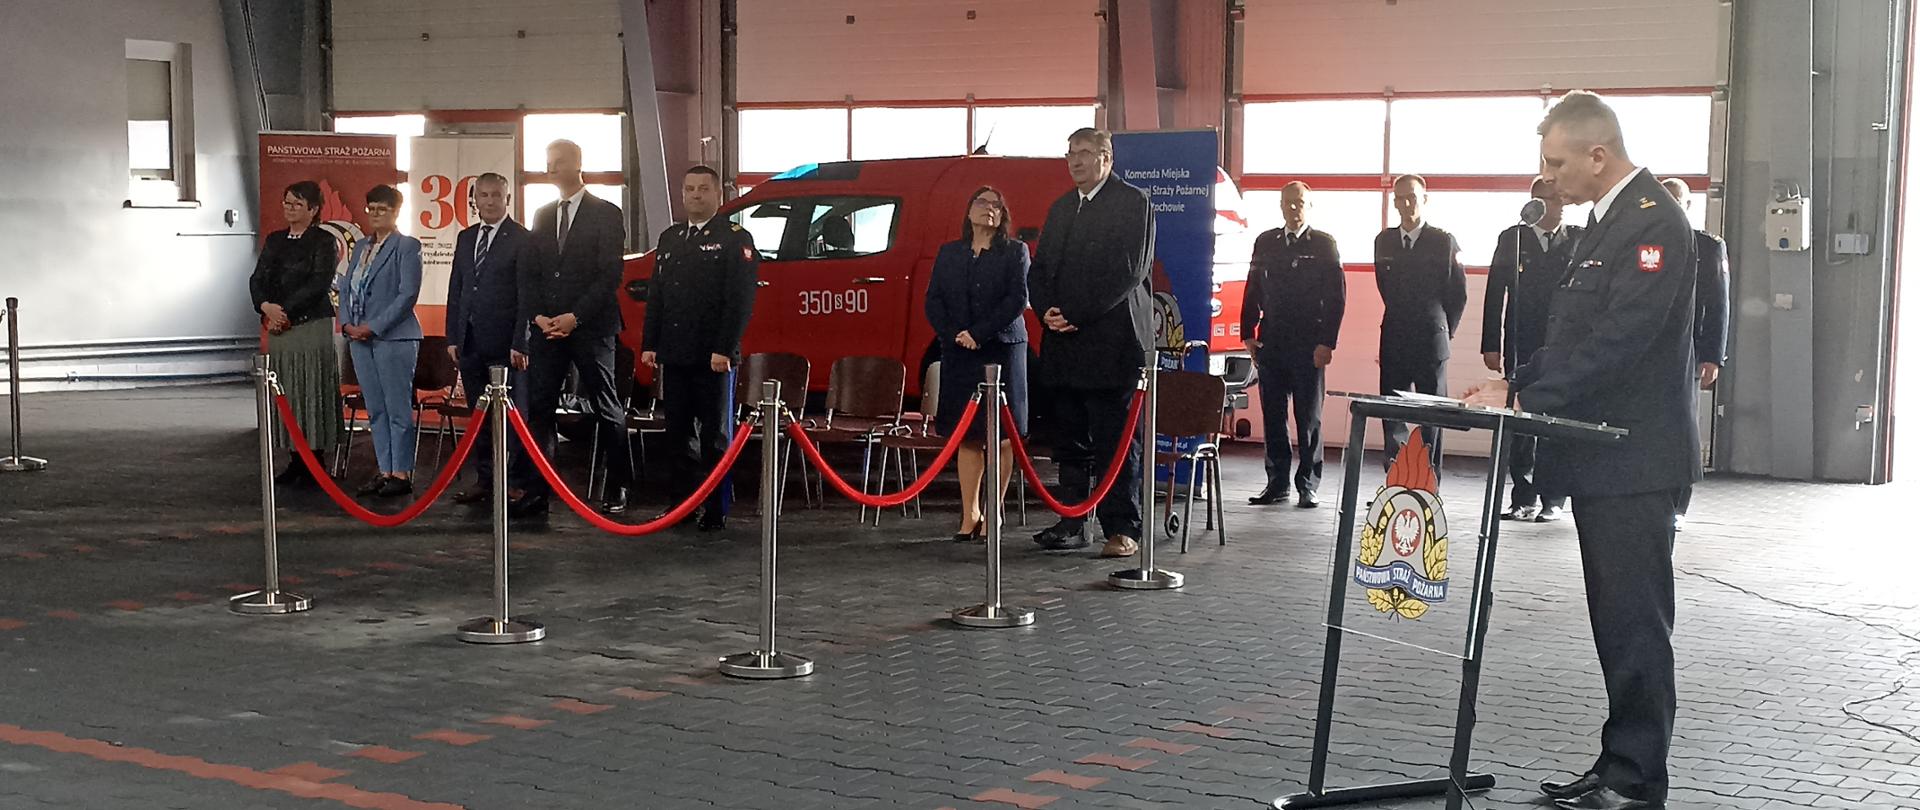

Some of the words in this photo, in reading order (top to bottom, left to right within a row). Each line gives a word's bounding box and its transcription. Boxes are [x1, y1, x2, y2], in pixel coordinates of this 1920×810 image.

[267, 145, 322, 155] PAŃSTWOWA
[325, 146, 351, 156] STRAŻ
[352, 147, 391, 157] POŻARNA
[1124, 169, 1160, 180] Komenda
[1161, 169, 1190, 181] Miejska
[1152, 185, 1174, 197] Straży
[1176, 184, 1209, 198] Pożarnej
[1355, 566, 1390, 584] PAŃSTWOWA
[1392, 567, 1411, 584] STRAŻ
[1411, 579, 1444, 598] POŻARNA
